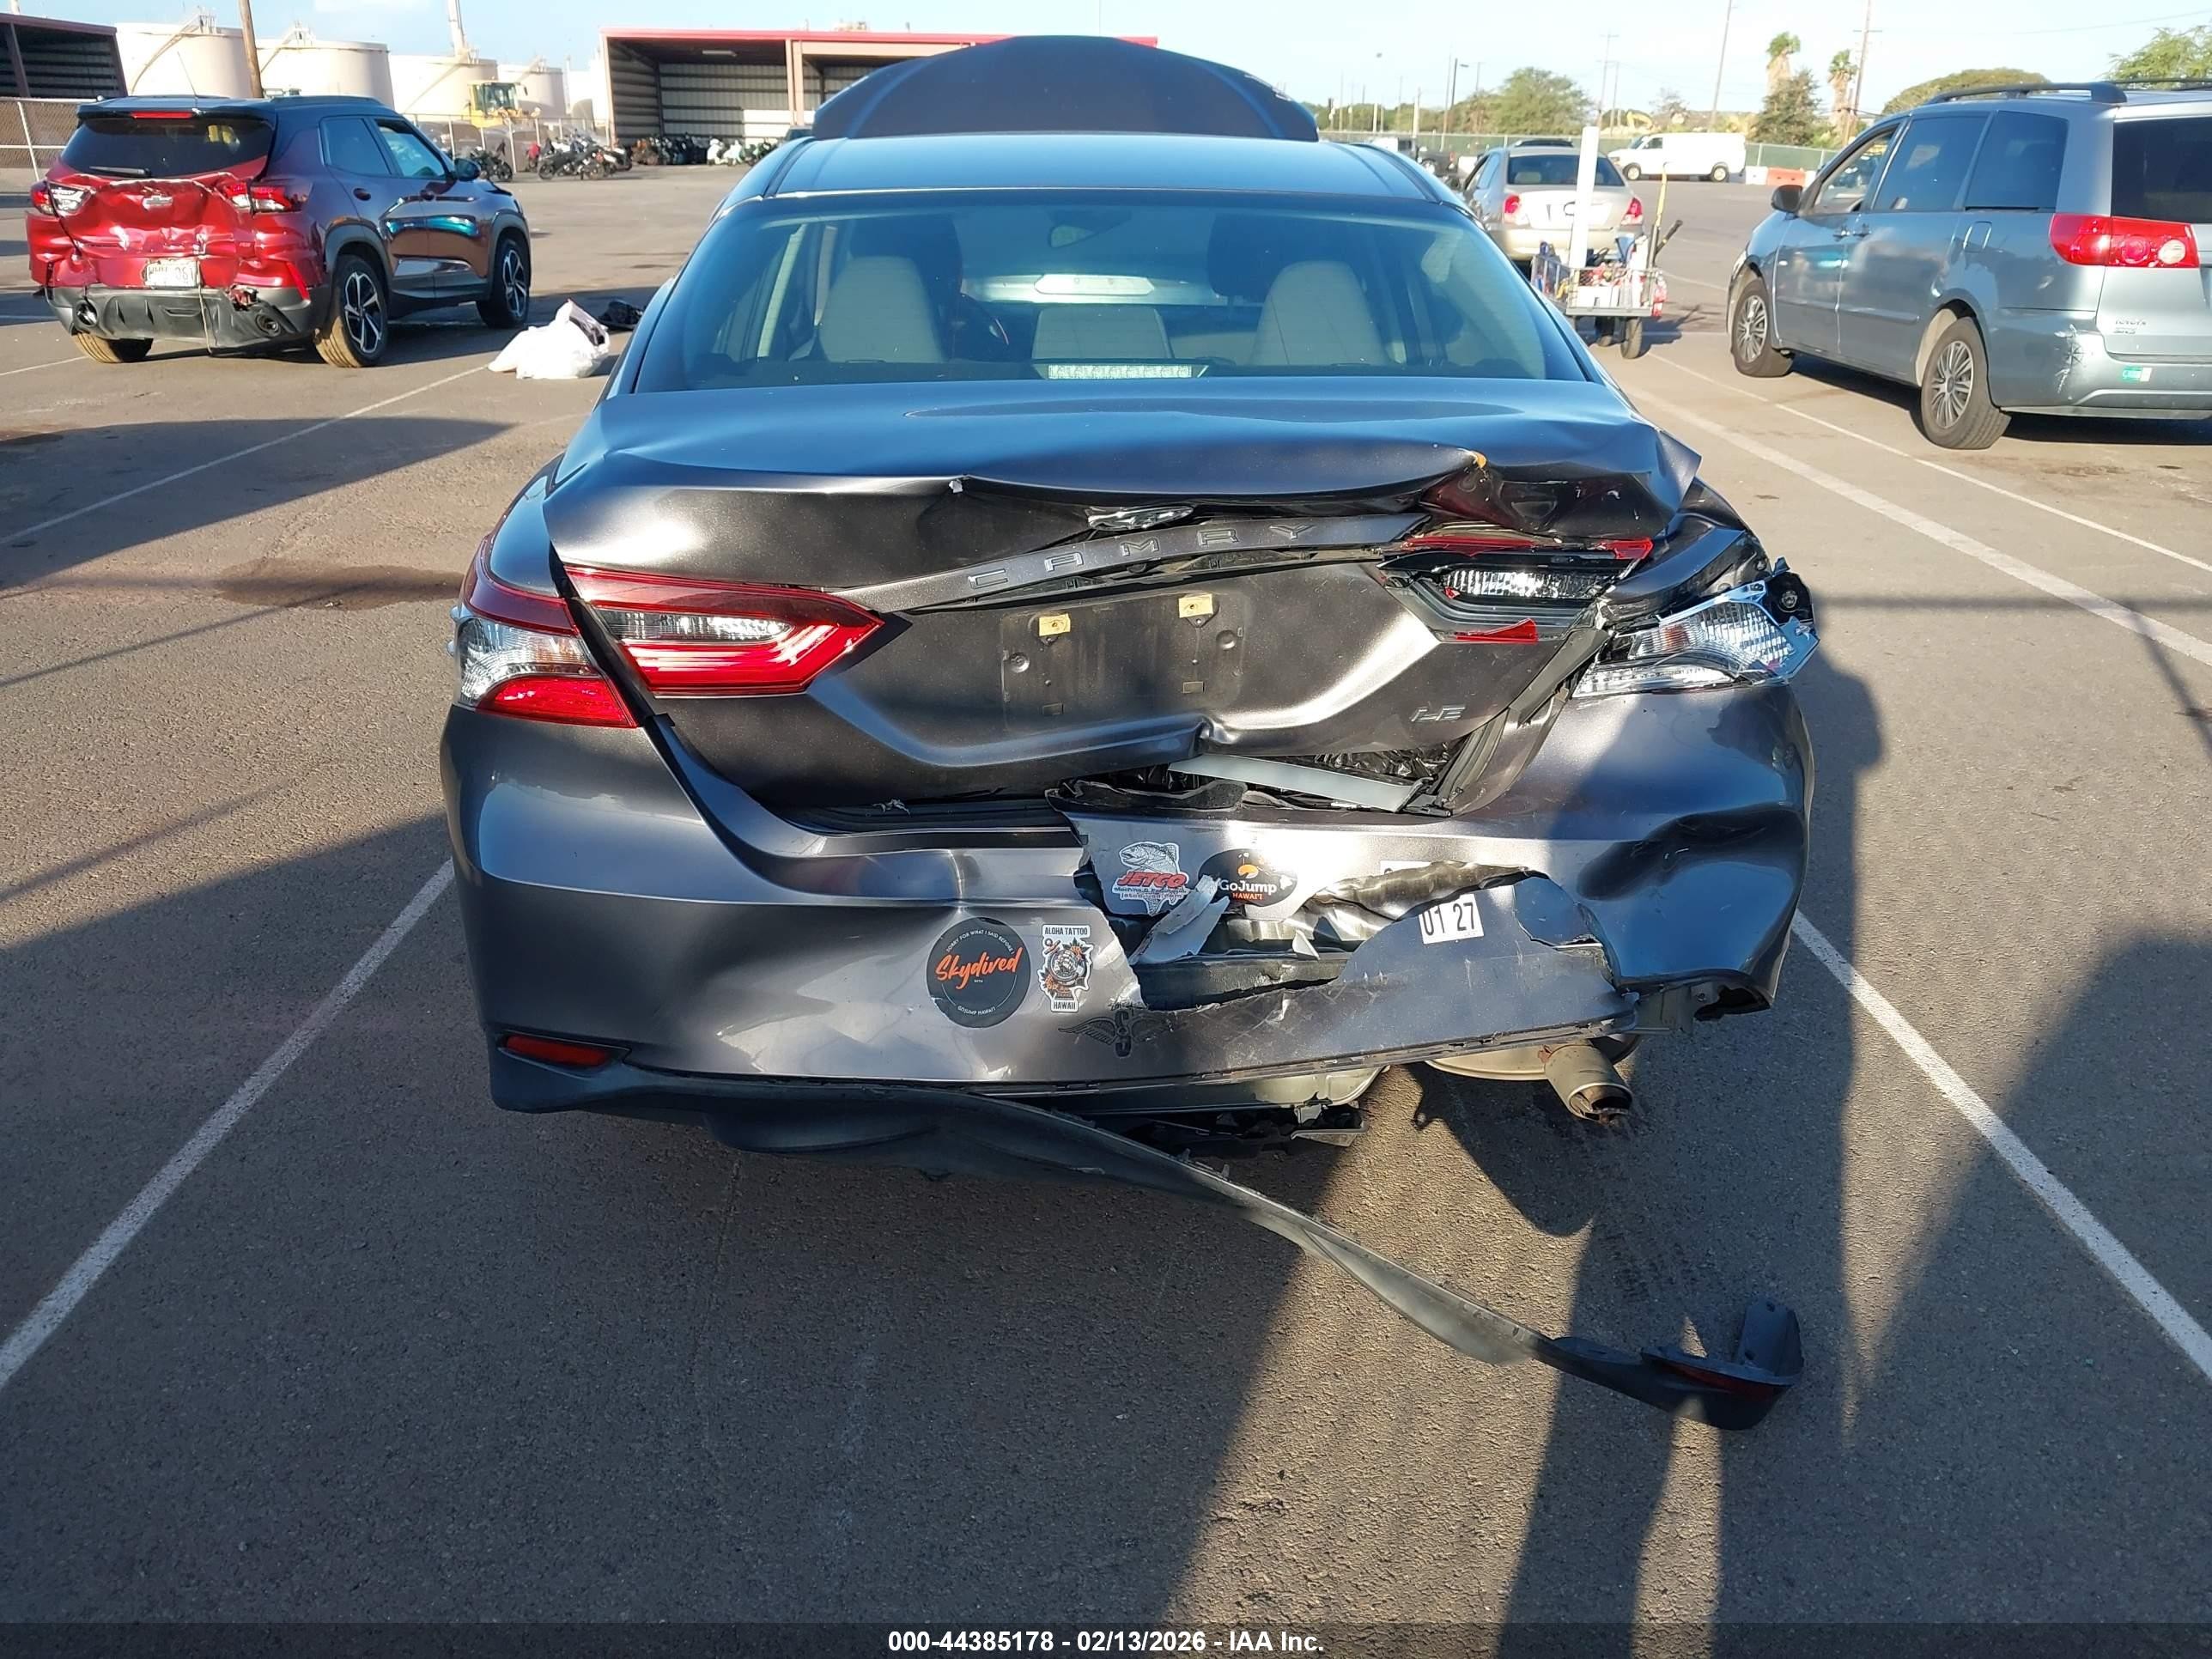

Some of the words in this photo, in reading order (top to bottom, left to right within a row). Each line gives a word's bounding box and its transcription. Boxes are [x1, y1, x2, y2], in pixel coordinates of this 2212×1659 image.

[967, 523, 1317, 590] CAMRY
[1409, 706, 1466, 722] LE
[1116, 871, 1187, 889] JETCO
[1219, 879, 1278, 896] GoJump
[1453, 902, 1474, 932] 27
[945, 937, 959, 952] SORRY
[998, 935, 1013, 951] BEFORE
[935, 946, 1024, 990] Skydived
[1053, 1001, 1076, 1010] HAWAII
